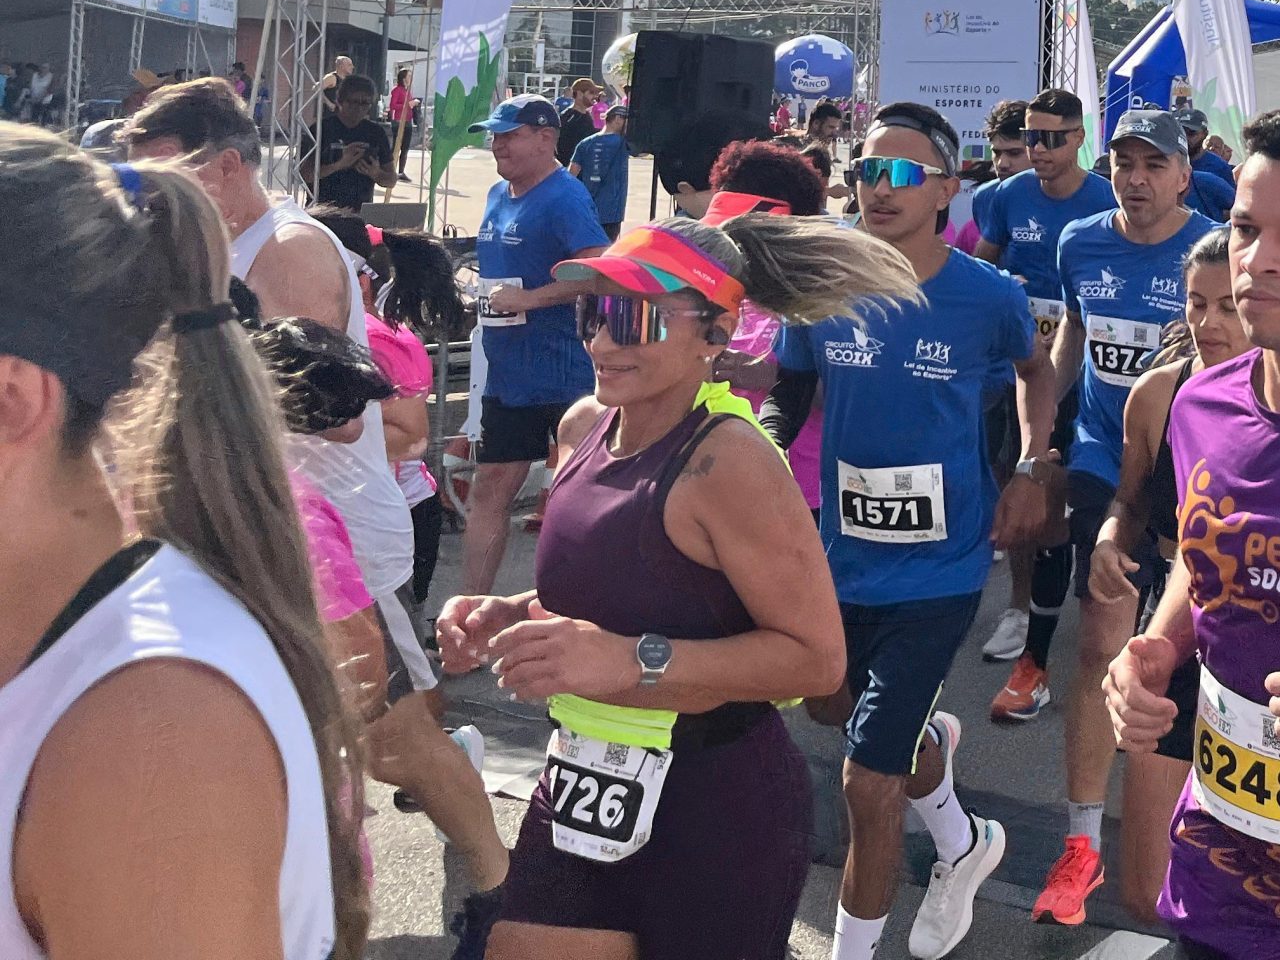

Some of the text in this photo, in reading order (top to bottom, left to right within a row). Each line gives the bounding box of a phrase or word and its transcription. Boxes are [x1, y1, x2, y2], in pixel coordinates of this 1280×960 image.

[798, 80, 827, 88] PANCO
[920, 84, 1000, 94] MINISTÉRIO DO
[935, 99, 983, 108] ESPORTE
[852, 497, 919, 526] 1571
